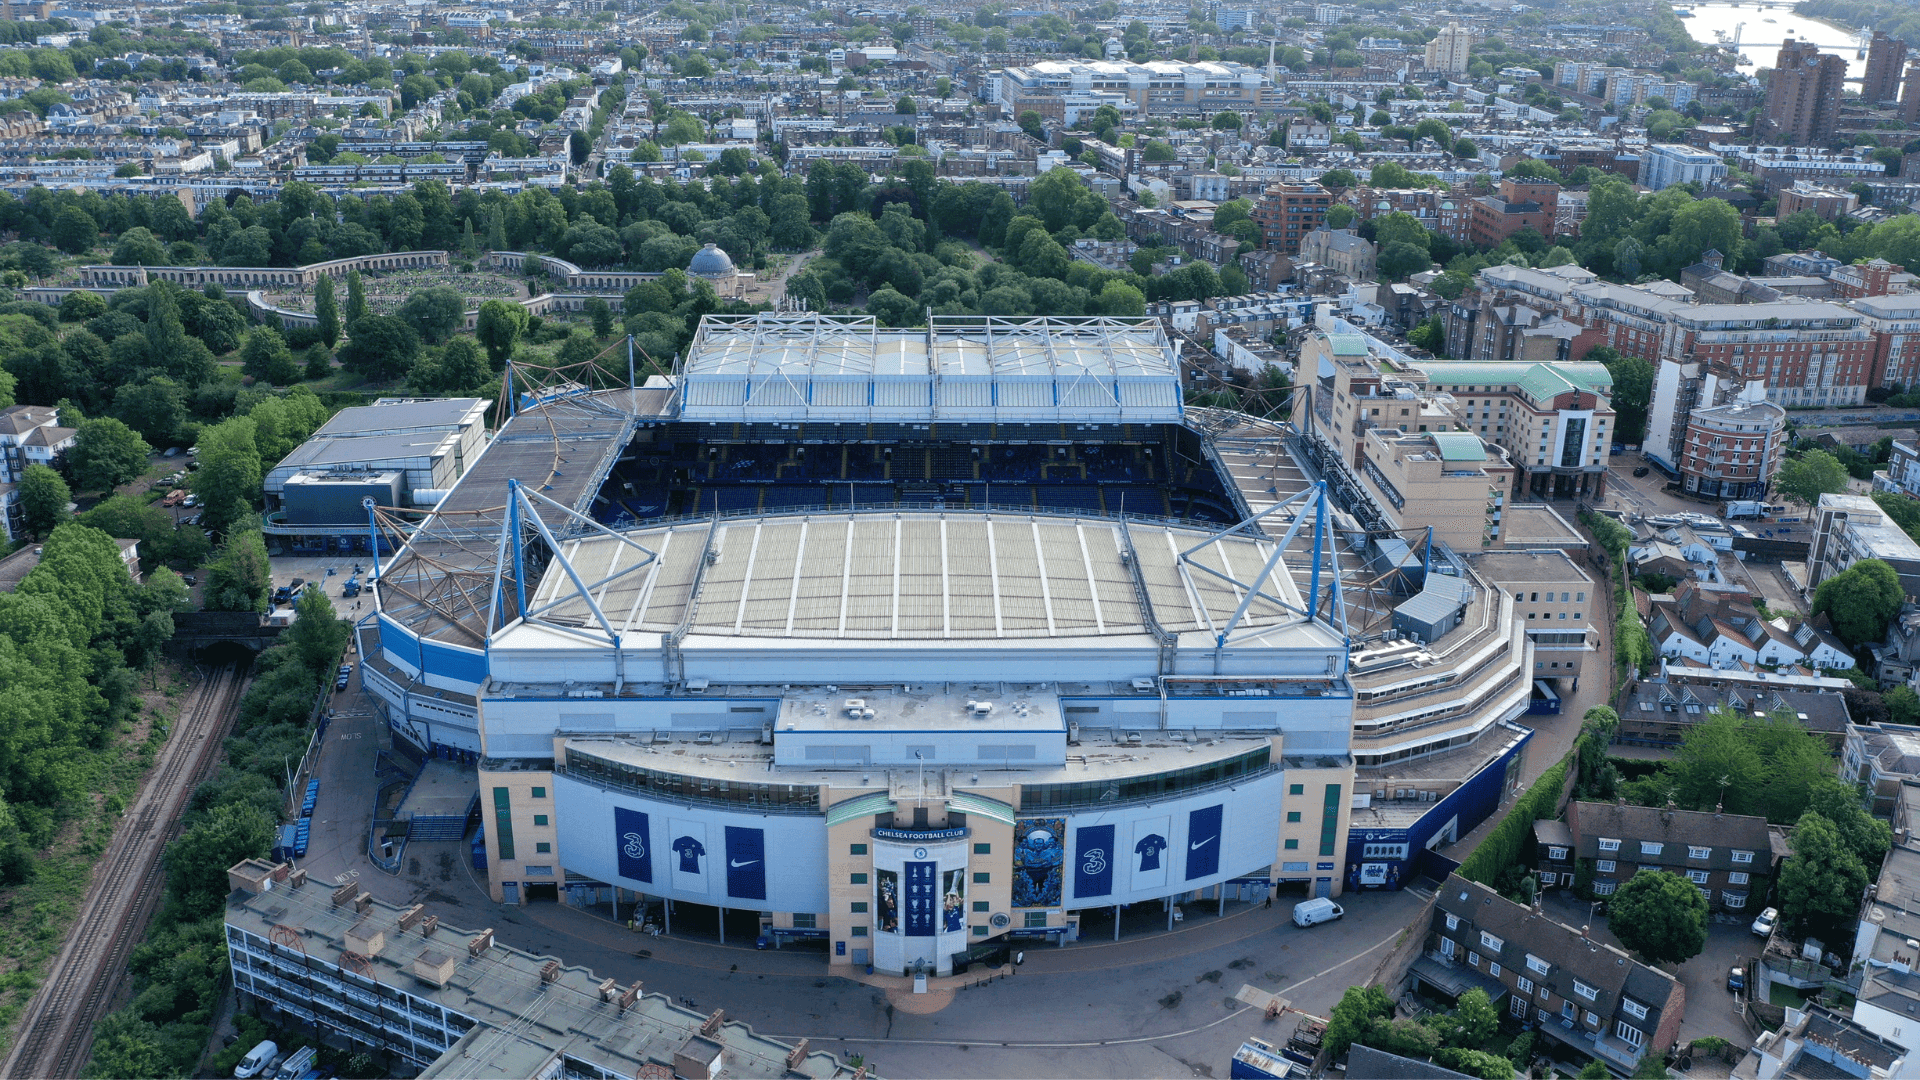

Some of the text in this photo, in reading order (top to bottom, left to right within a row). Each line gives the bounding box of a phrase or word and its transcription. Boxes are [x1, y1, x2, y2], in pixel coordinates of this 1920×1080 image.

[340, 732, 362, 740] SLOW
[878, 830, 908, 839] CHELSEA
[624, 832, 644, 858] 3
[1083, 848, 1106, 875] 3
[334, 868, 360, 884] SLOW
